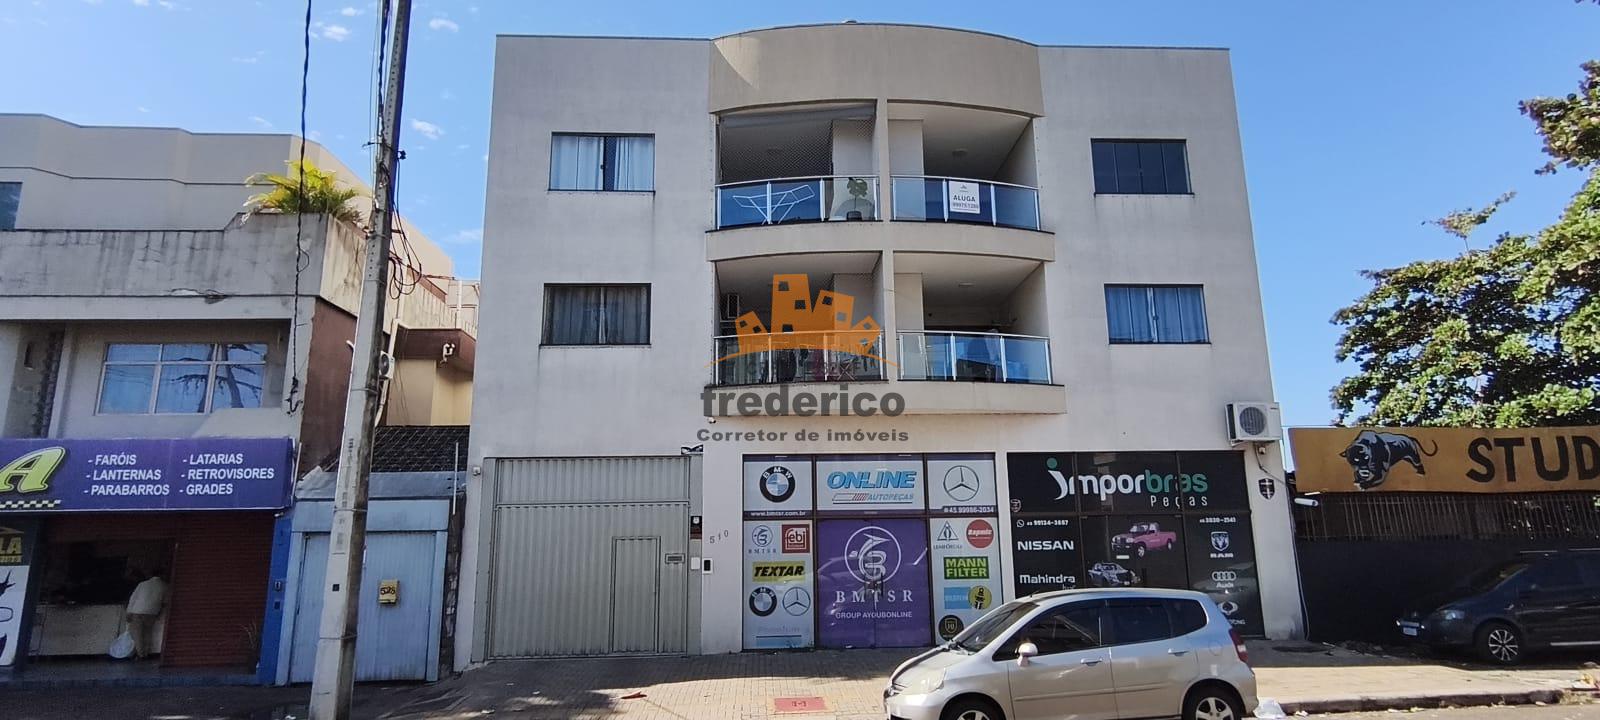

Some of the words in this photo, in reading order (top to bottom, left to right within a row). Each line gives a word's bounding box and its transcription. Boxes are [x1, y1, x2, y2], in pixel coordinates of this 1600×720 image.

[95, 452, 137, 466] FARÓIS
[189, 453, 244, 466] LATARIAS
[1465, 435, 1600, 483] STUD
[93, 469, 162, 481] LANTERNAS
[188, 468, 274, 480] RETROVISORES
[91, 484, 170, 496] PARABARROS
[186, 483, 233, 495] GRADES
[867, 493, 914, 502] AUTOPEÇAS
[709, 530, 729, 544] 510
[1017, 540, 1074, 551] NISSAN
[945, 558, 986, 568] MANN
[754, 565, 804, 577] TEXTAR
[946, 567, 987, 577] FILTER
[1019, 574, 1076, 584] Mahindra
